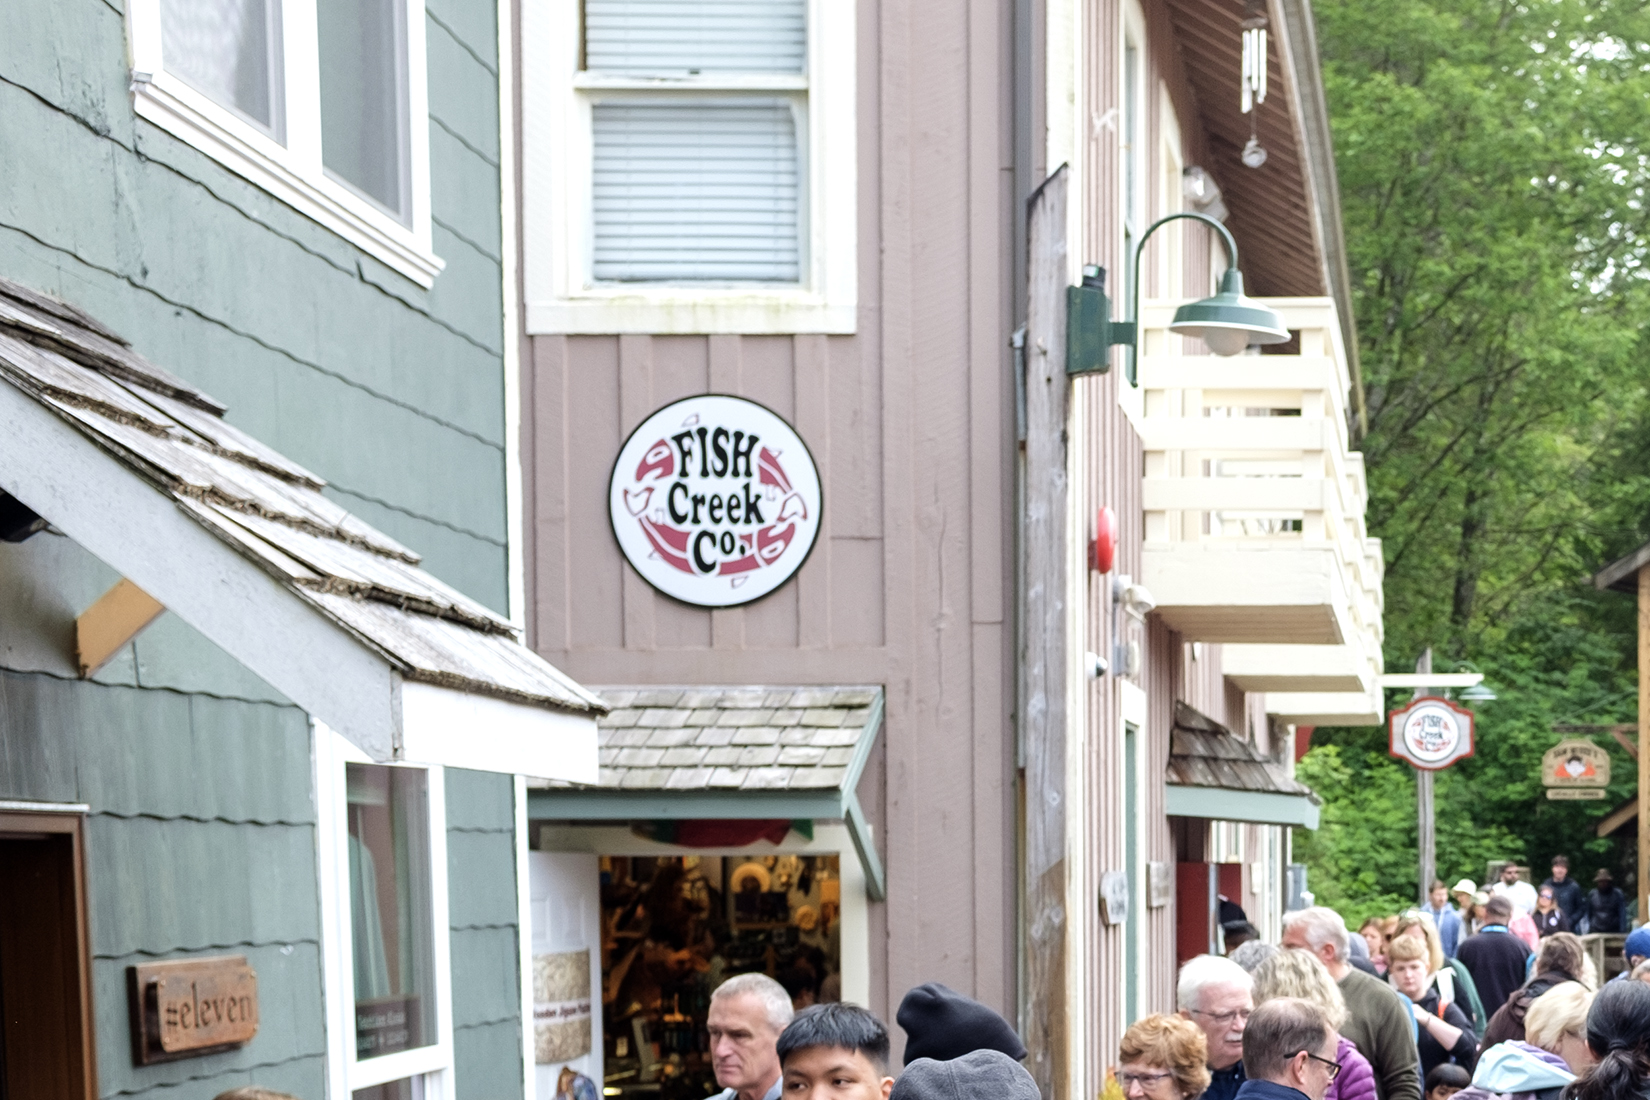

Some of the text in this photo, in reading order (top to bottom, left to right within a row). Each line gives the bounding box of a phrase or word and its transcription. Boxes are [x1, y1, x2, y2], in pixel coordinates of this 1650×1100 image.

[671, 426, 760, 478] FISH
[668, 481, 765, 525] Creek
[693, 529, 747, 574] Co.
